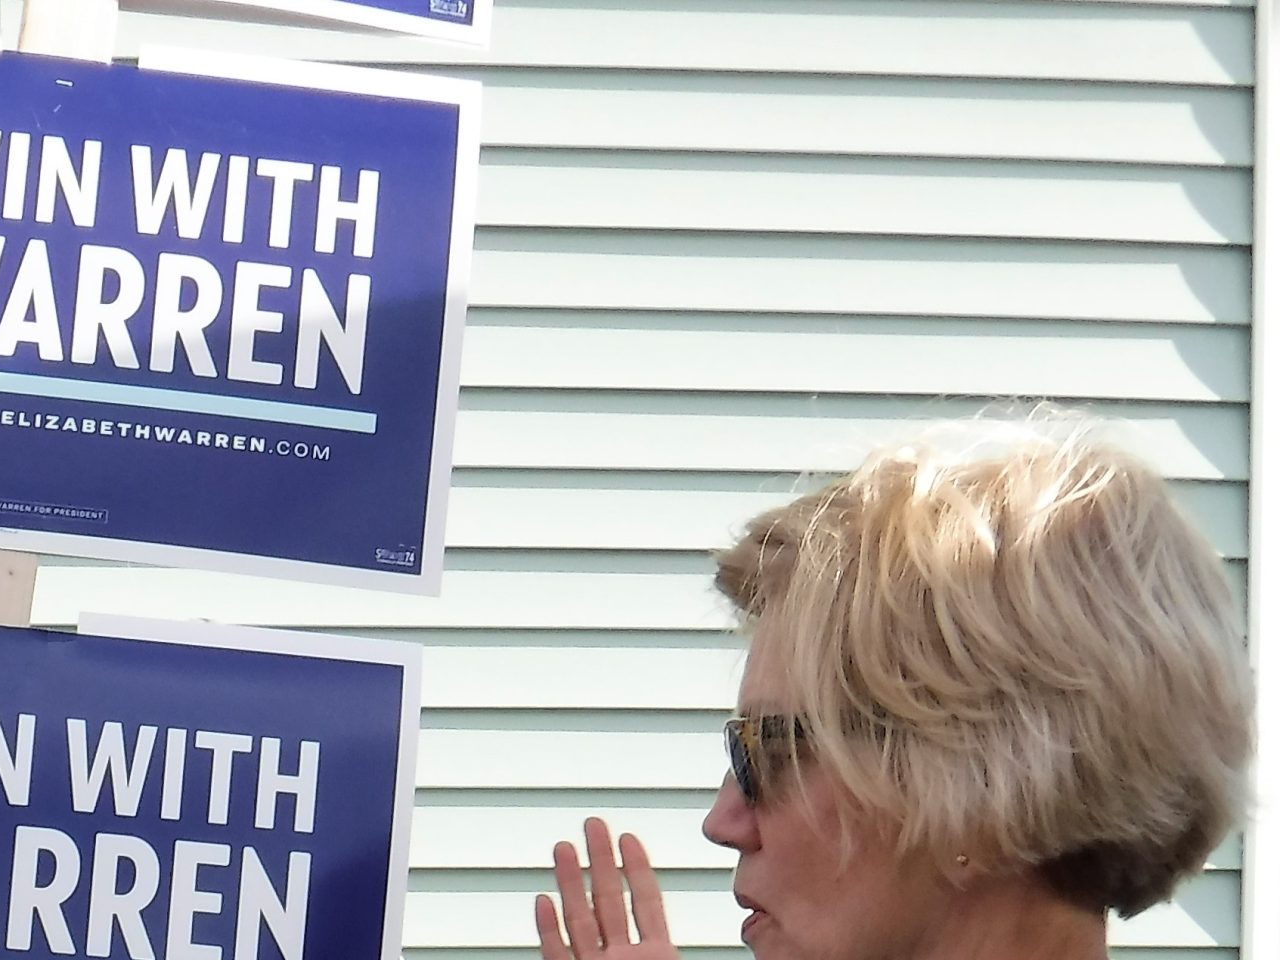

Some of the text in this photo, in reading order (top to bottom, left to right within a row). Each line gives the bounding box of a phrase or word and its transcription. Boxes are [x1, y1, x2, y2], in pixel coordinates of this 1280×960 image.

[131, 144, 381, 259] WITH
[34, 505, 52, 514] FOR
[53, 507, 104, 520] PRESIDENT
[66, 718, 321, 834] WITH
